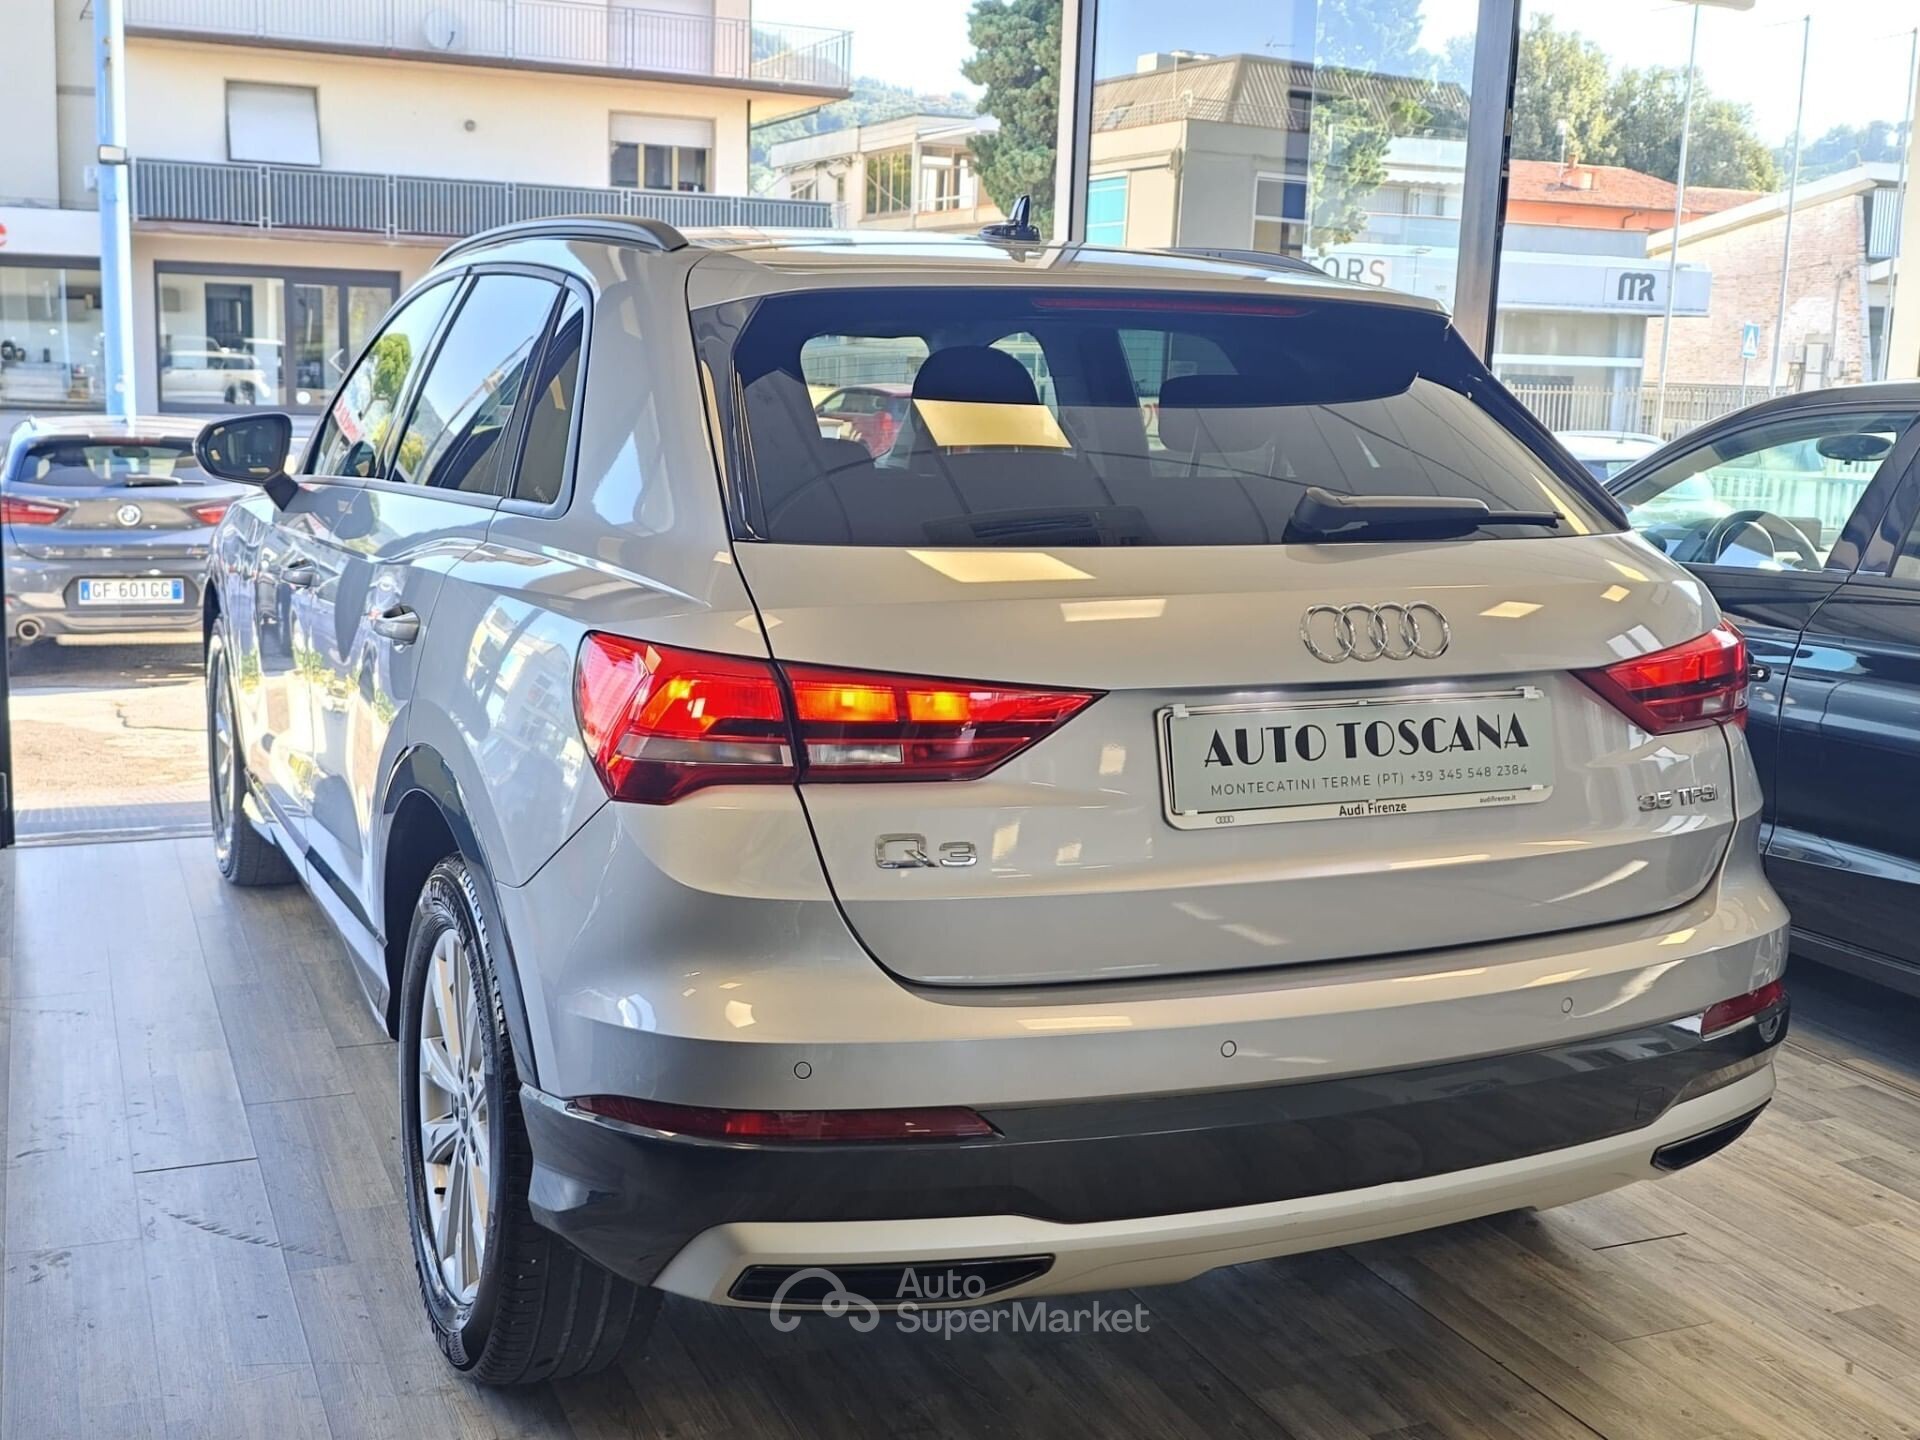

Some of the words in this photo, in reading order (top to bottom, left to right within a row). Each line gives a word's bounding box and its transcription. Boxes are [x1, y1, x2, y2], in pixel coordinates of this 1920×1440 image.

[92, 582, 116, 598] GF
[119, 582, 170, 598] 601GG
[1204, 724, 1327, 768] AUTO
[1336, 712, 1529, 759] TOSCANA
[1211, 778, 1316, 796] MONTECATINI
[1322, 774, 1371, 789] TERME
[1377, 771, 1404, 787] (PT)
[1410, 771, 1433, 783] +39
[1439, 768, 1462, 781] 345
[1467, 766, 1492, 779] 548
[1497, 763, 1528, 777] 2384
[1339, 803, 1364, 816] Audi
[1368, 801, 1407, 814] Firenze
[1638, 791, 1673, 812] 35
[1677, 784, 1719, 806] TFSI
[875, 833, 977, 869] Q3
